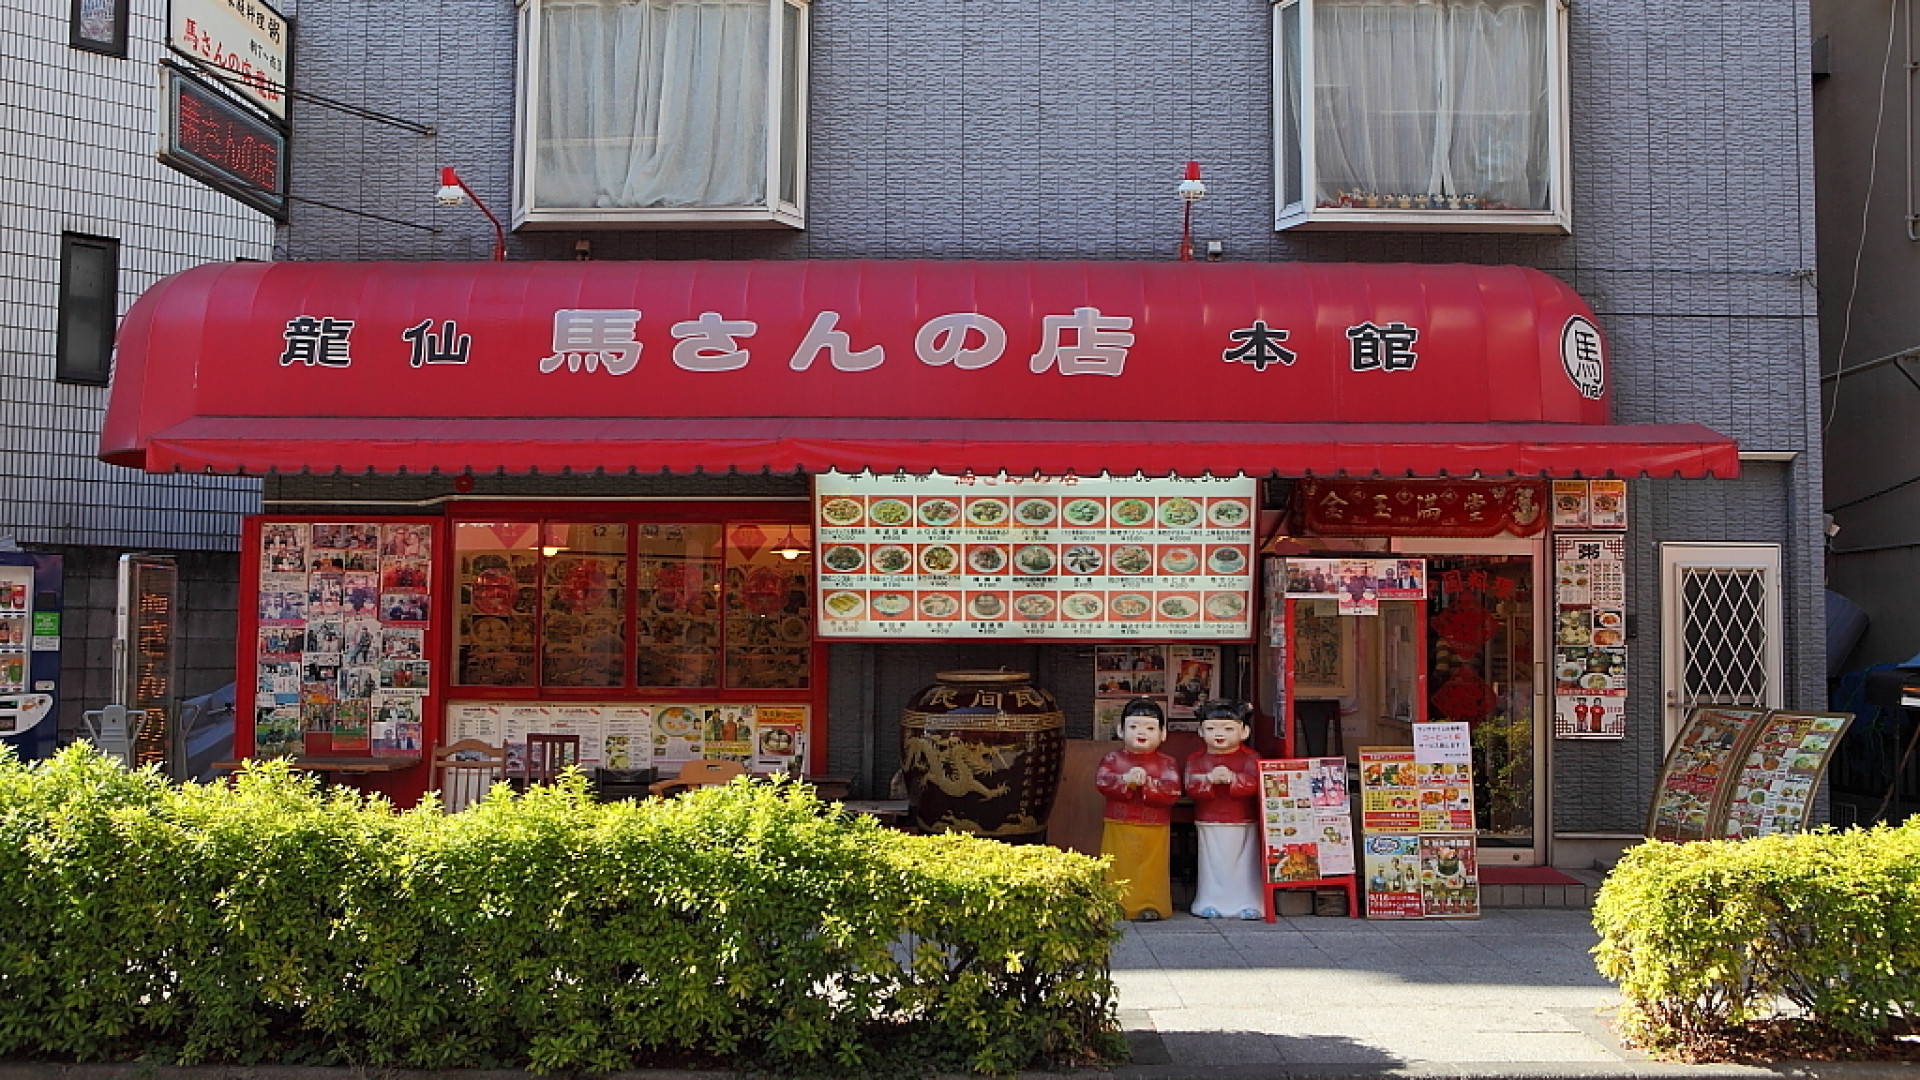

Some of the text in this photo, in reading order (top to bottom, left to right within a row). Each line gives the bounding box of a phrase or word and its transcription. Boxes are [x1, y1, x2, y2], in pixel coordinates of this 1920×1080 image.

[280, 308, 1419, 376] 龍仙 馬さんの店 本館
[1574, 329, 1602, 385] 馬
